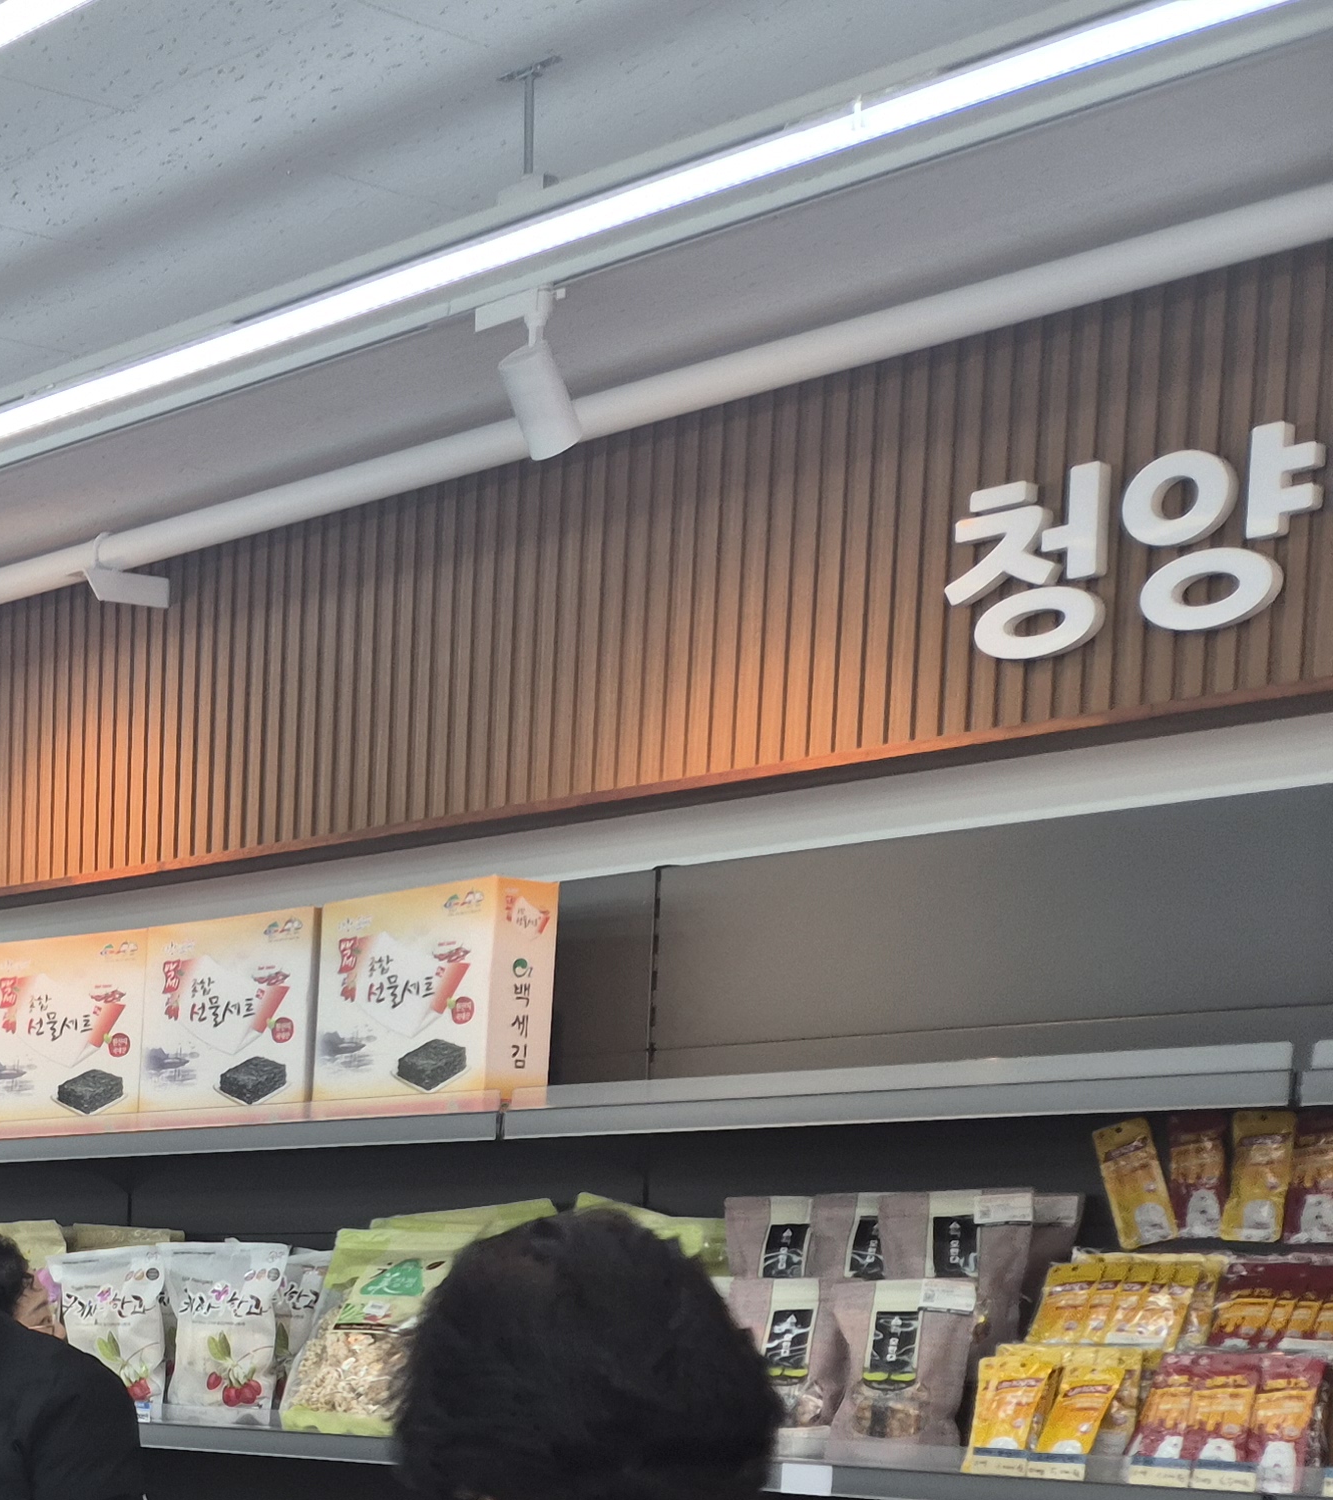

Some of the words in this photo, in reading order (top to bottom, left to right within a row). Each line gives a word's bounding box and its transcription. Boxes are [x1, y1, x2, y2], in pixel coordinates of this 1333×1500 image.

[944, 420, 1326, 660] 청양
[367, 974, 436, 1010] 선물세트
[27, 1012, 94, 1042] 선물세트
[189, 996, 256, 1028] 선물세트
[511, 983, 531, 1069] 백세김
[110, 1291, 151, 1320] 한과
[226, 1291, 271, 1319] 한과
